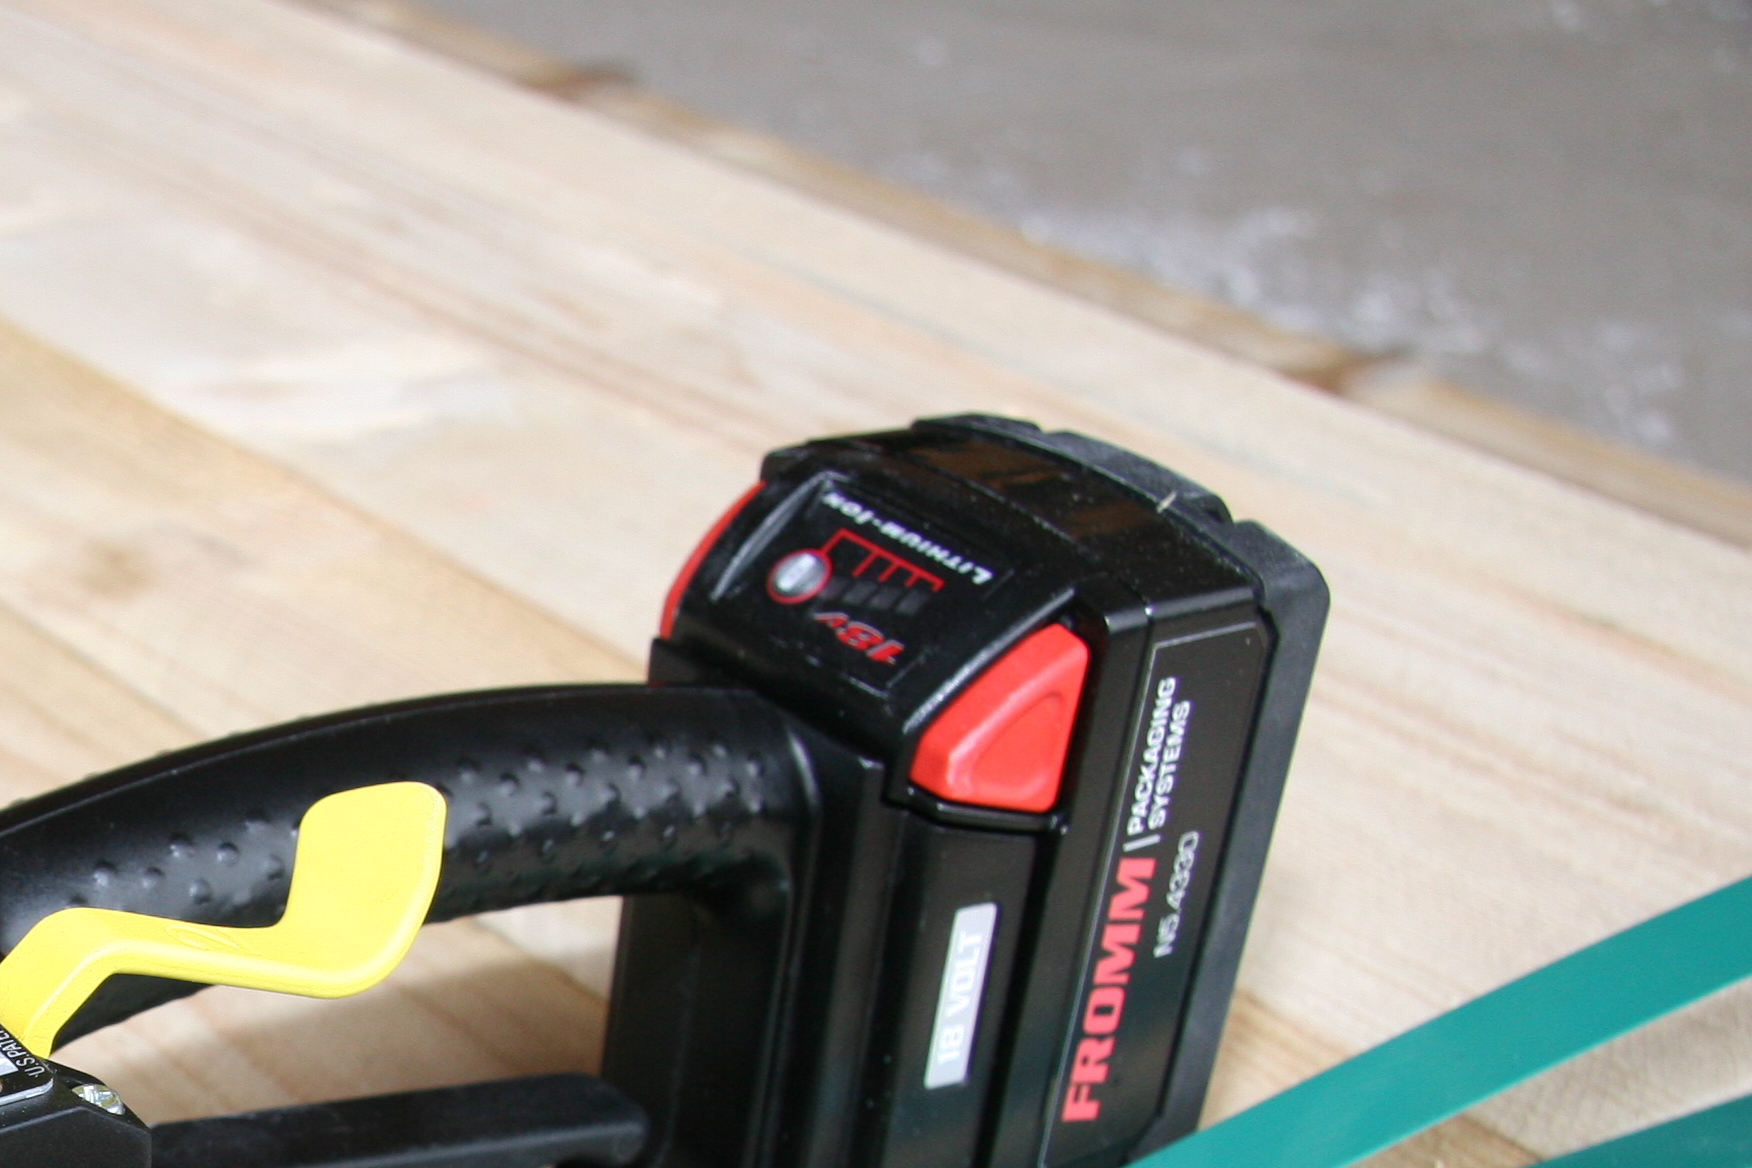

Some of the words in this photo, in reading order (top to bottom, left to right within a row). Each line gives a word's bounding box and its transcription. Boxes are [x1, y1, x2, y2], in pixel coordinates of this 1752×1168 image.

[811, 612, 905, 666] 18V
[1127, 675, 1177, 836] PACKAGING
[1148, 700, 1192, 831] SYSTEMS
[947, 931, 983, 1018] VOLT
[1061, 858, 1156, 1122] FROMM
[937, 1024, 965, 1065] 18
